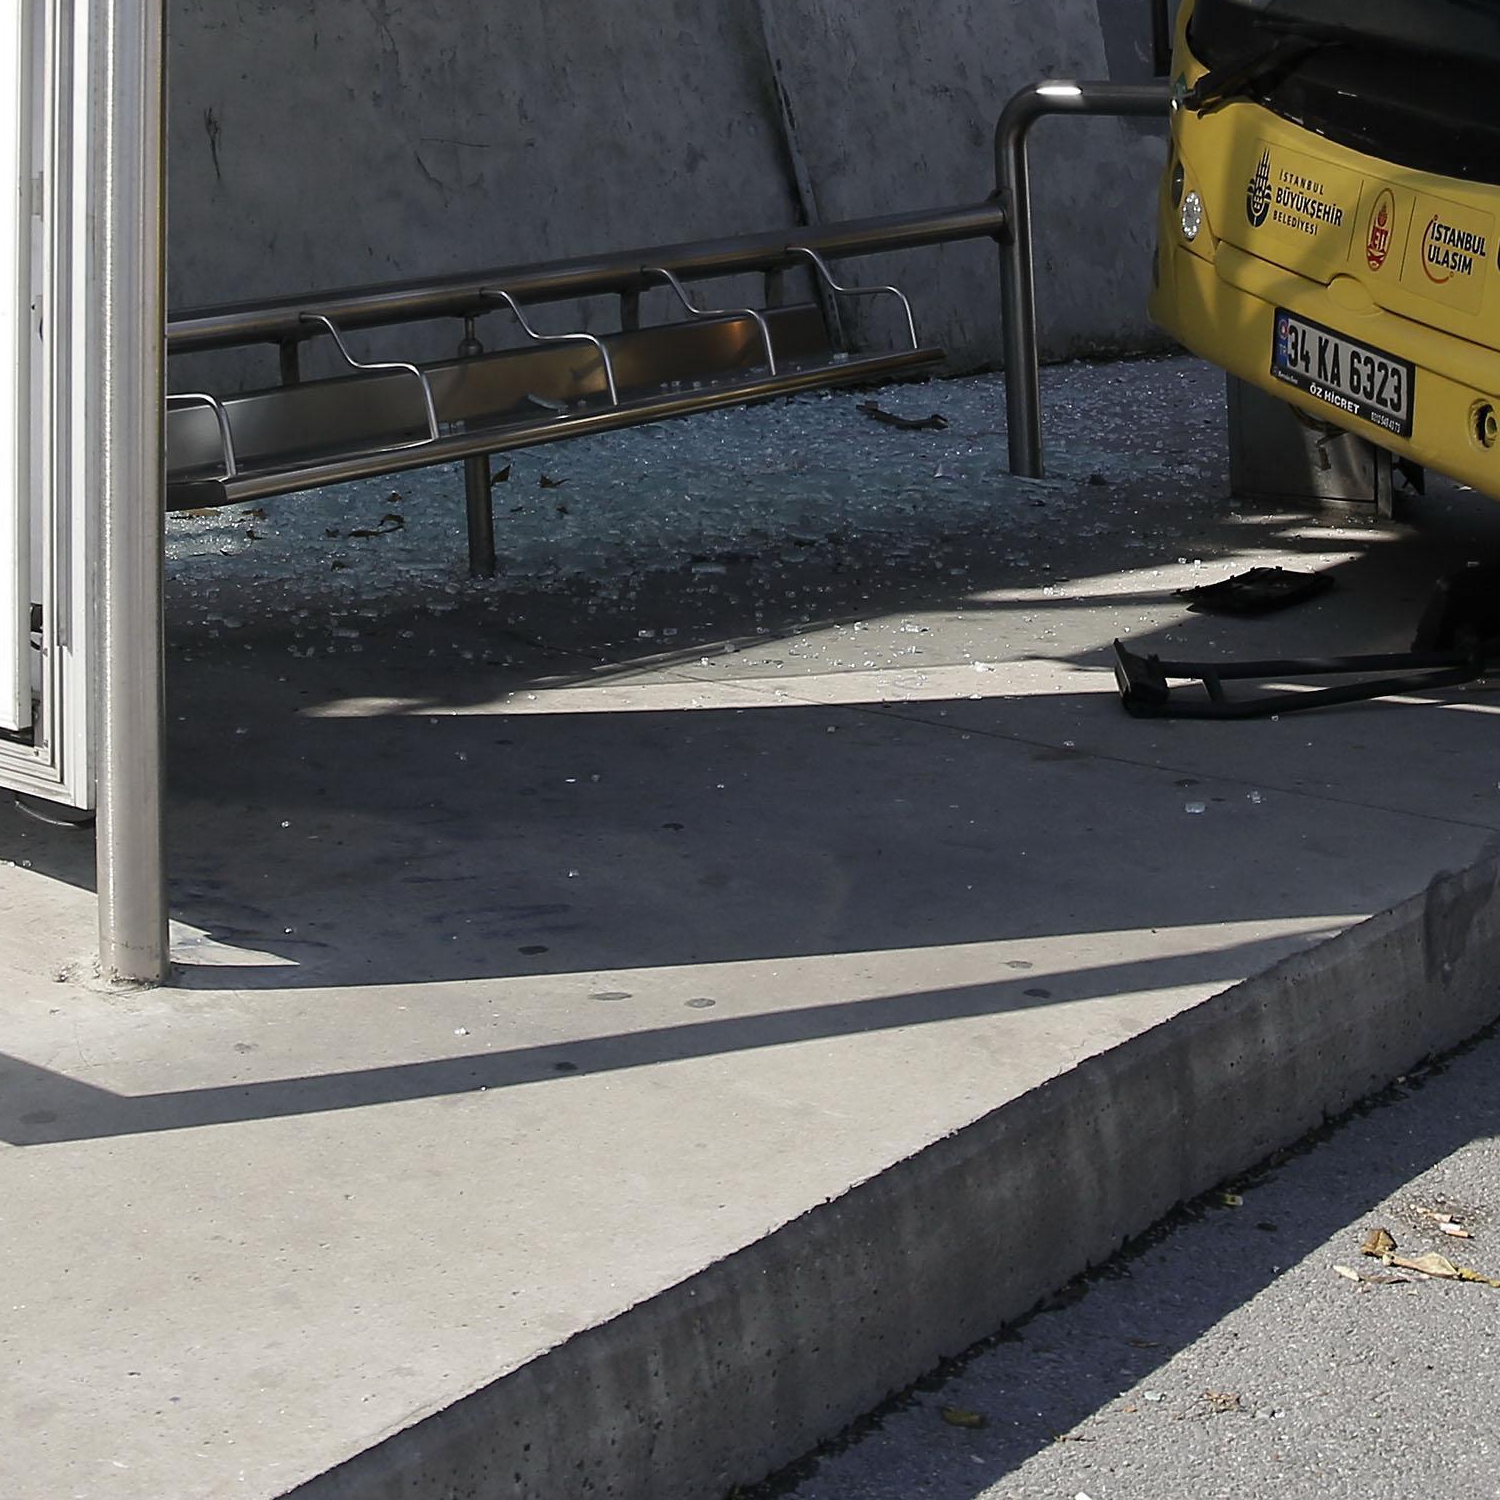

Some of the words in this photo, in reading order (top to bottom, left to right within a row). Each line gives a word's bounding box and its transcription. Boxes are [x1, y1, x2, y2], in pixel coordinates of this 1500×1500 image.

[1275, 186, 1343, 226] BÜYÜKŞEHİR
[1287, 324, 1311, 373] 34
[1317, 336, 1341, 388] KA
[1350, 350, 1401, 412] 6323
[1309, 382, 1322, 398] ÖZ
[1324, 390, 1360, 415] HİCRET
